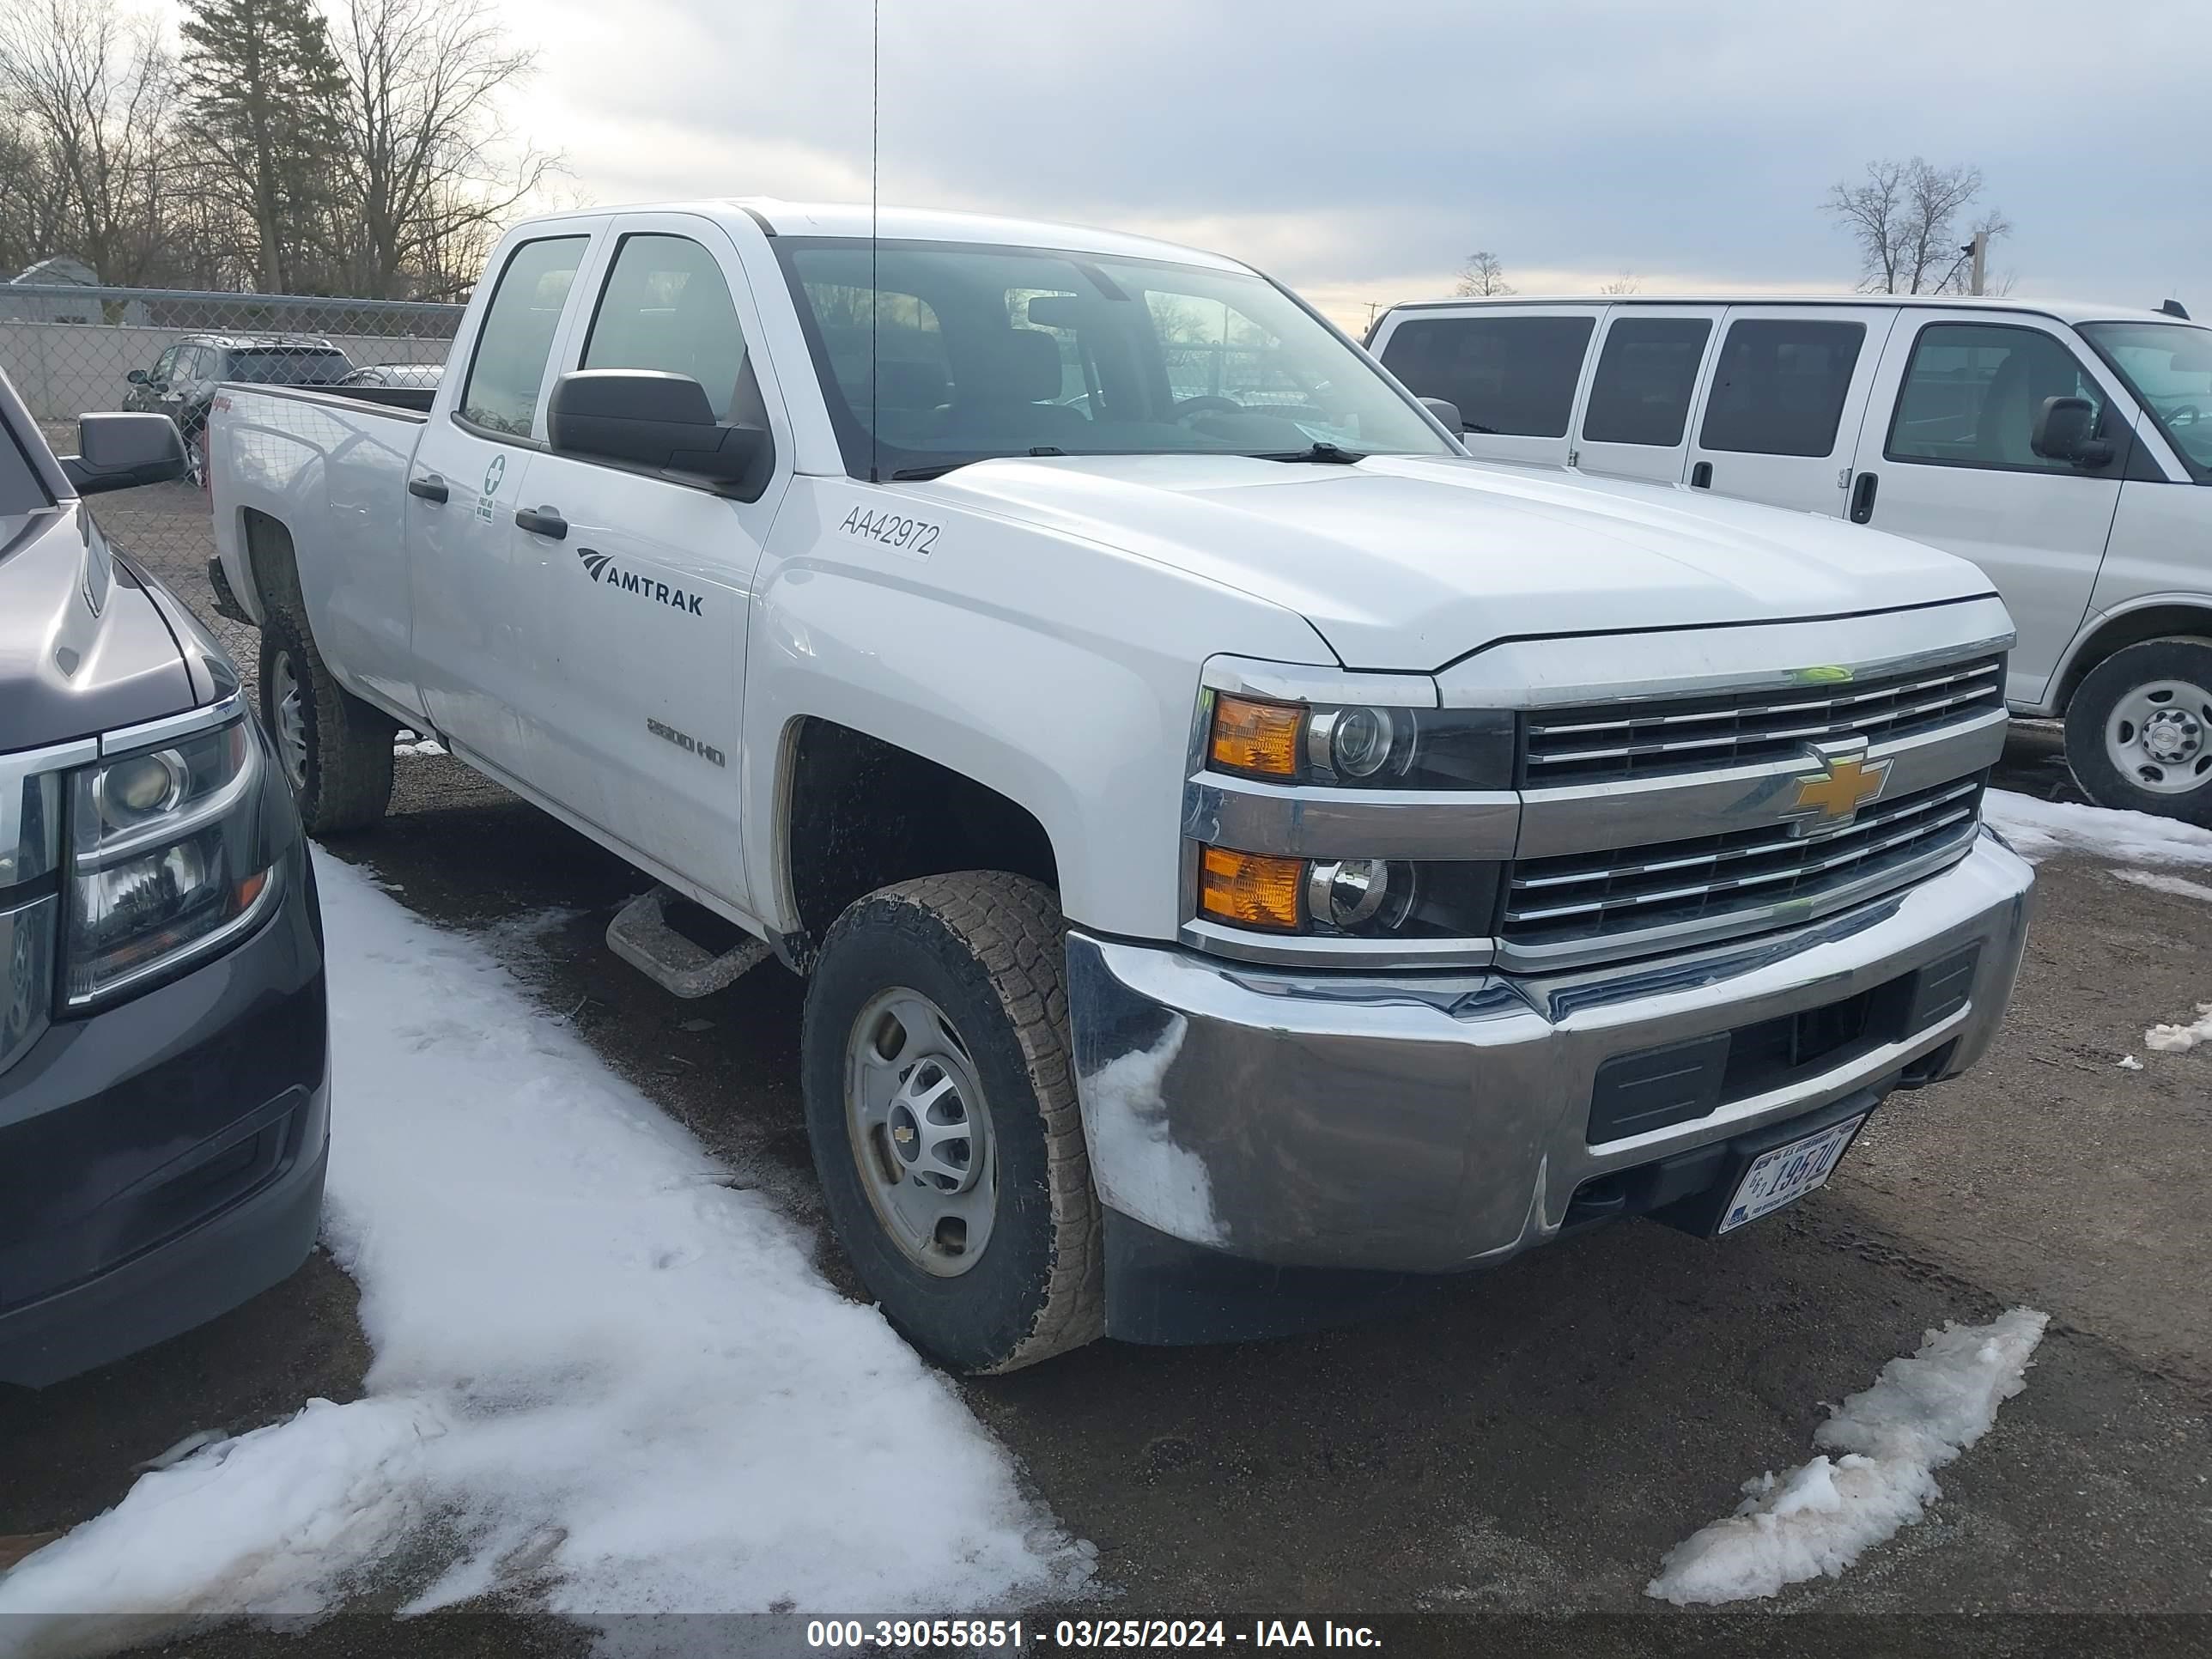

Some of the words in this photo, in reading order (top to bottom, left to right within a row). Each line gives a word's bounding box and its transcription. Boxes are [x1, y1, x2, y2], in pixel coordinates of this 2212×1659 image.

[839, 505, 941, 556] AA42972
[606, 567, 704, 617] AMTRAK
[647, 717, 695, 753] 2500
[696, 741, 726, 768] HD
[1765, 1138, 1842, 1197] 1957U
